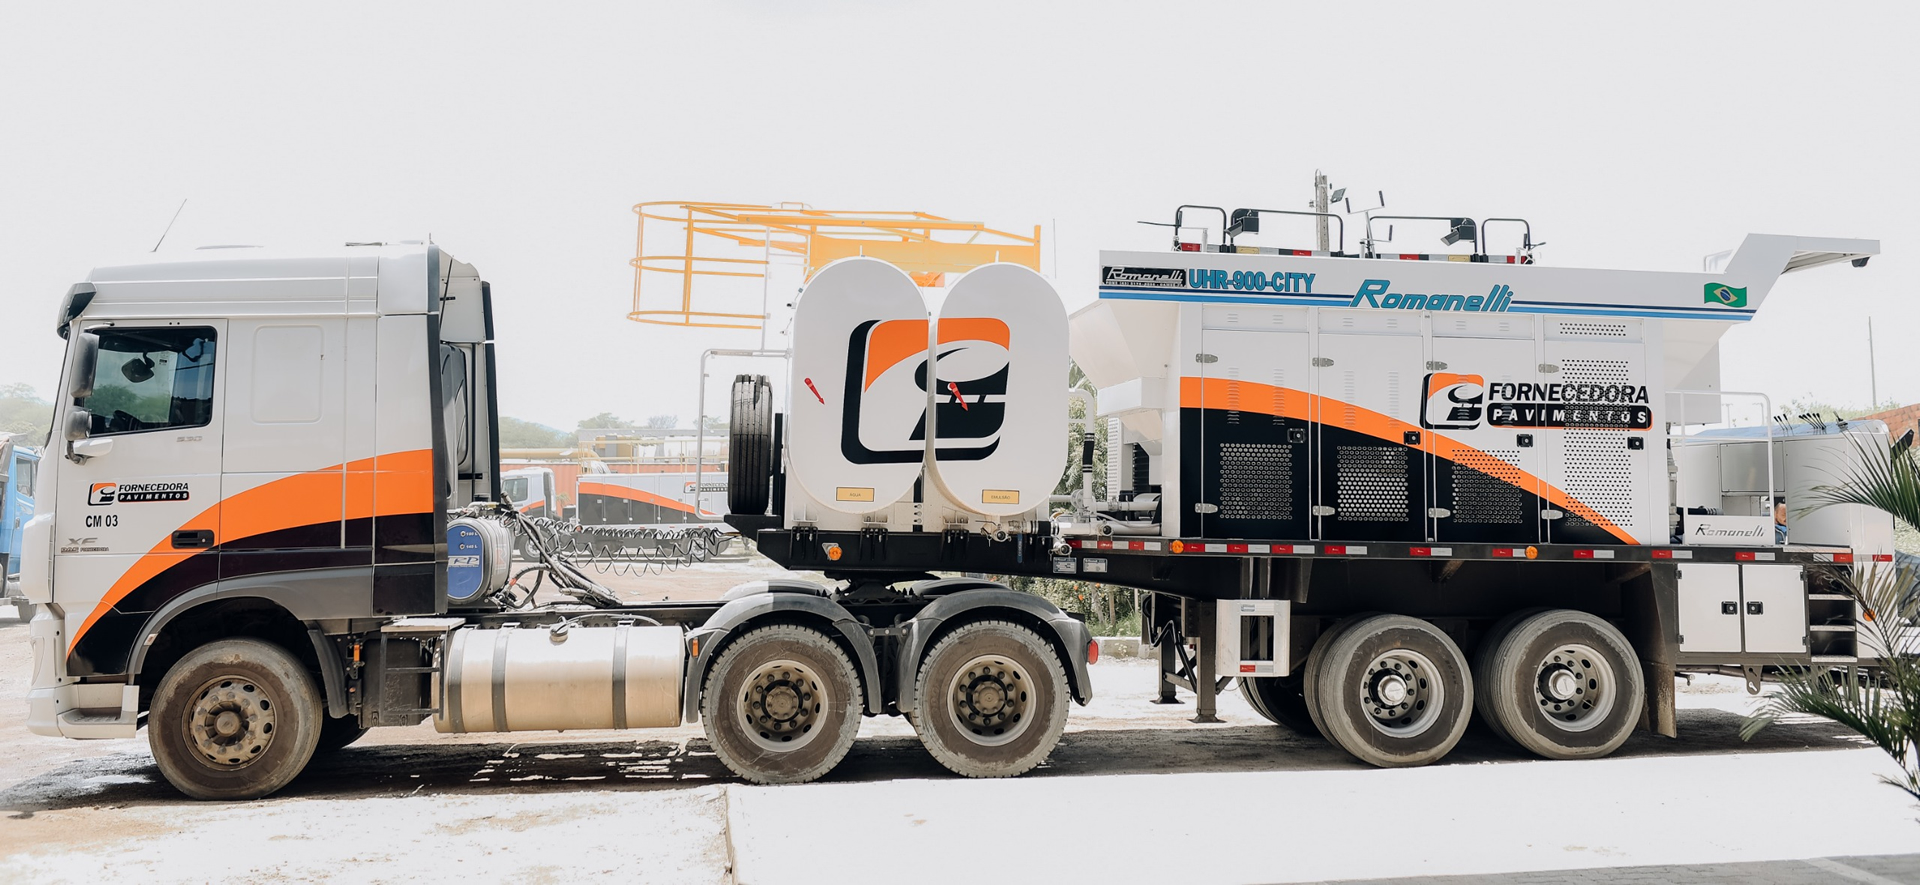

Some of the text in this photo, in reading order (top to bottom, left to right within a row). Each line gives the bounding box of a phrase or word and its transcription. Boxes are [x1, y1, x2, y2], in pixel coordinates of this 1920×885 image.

[1107, 267, 1183, 281] Romanelli
[1188, 268, 1316, 293] UHR-900-CITY
[1350, 279, 1514, 312] Romanelli
[1488, 382, 1650, 404] FORNECEDORA
[1492, 408, 1648, 424] PAVIMENTOS
[118, 482, 189, 492] FORNECEDORA
[119, 492, 188, 501] PAVIMENTOS
[85, 514, 119, 528] CM 03
[1695, 523, 1766, 537] Romanelli
[67, 537, 98, 546] XF
